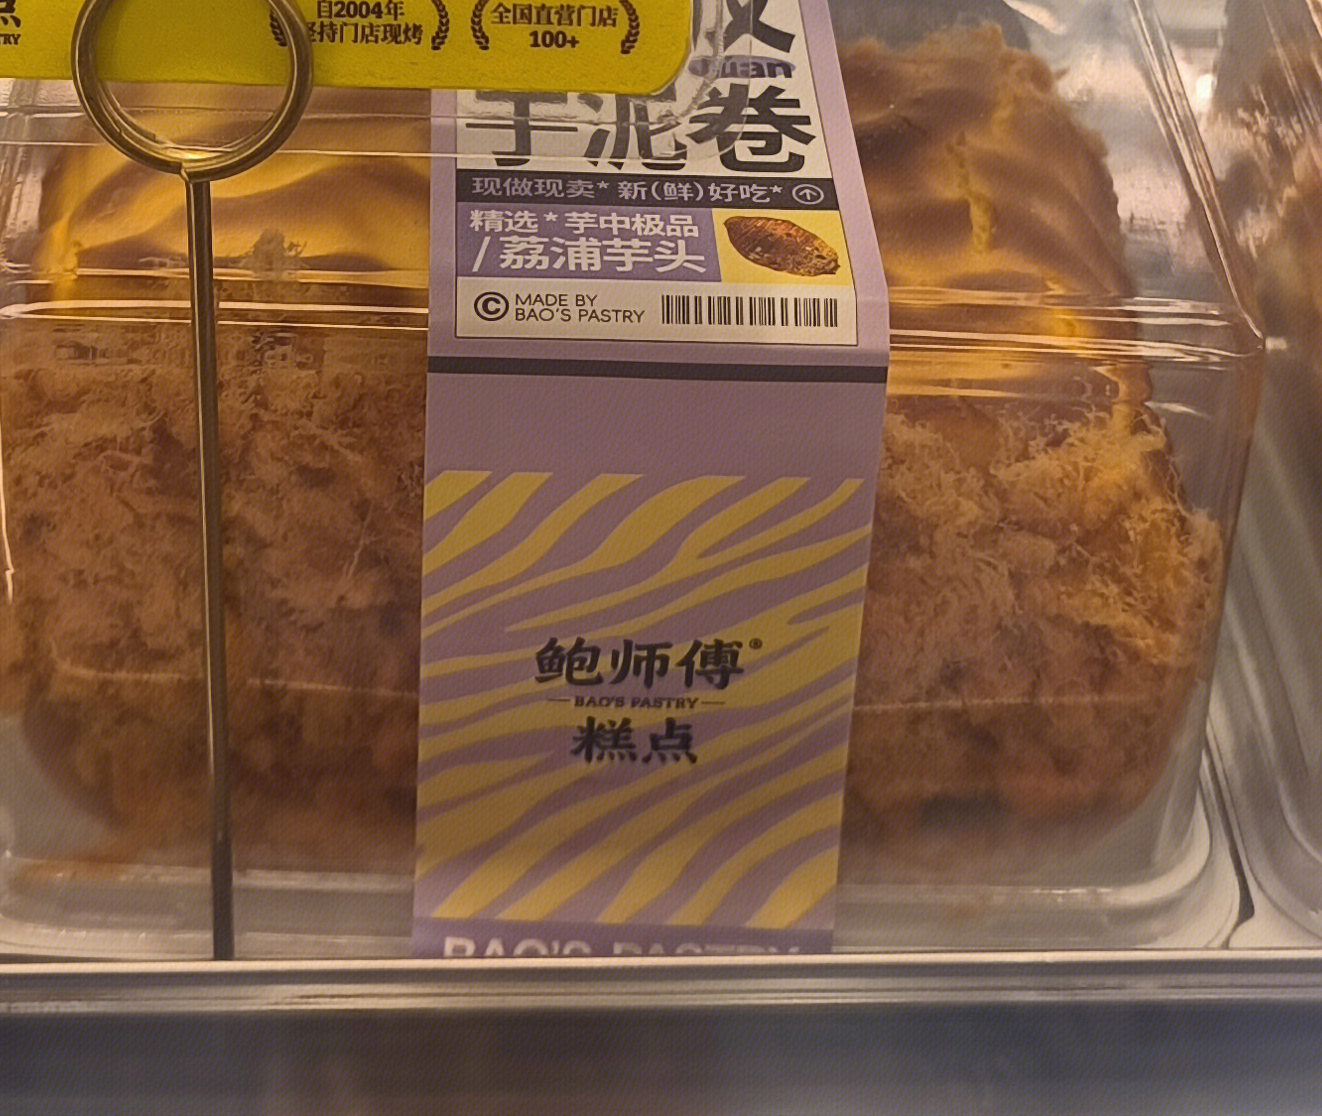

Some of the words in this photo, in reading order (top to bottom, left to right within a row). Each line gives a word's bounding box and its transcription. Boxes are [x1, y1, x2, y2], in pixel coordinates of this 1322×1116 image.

[490, 1, 620, 28] 全国直营门店
[529, 29, 580, 49] 100+
[514, 293, 569, 307] MADE
[574, 294, 598, 308] BY
[515, 307, 572, 322] BAO'S
[577, 308, 646, 324] PASTRY
[534, 637, 744, 690] 鲍师傅
[574, 696, 625, 708] BAO'S
[630, 697, 699, 709] PASTRY
[570, 715, 698, 764] 糕点
